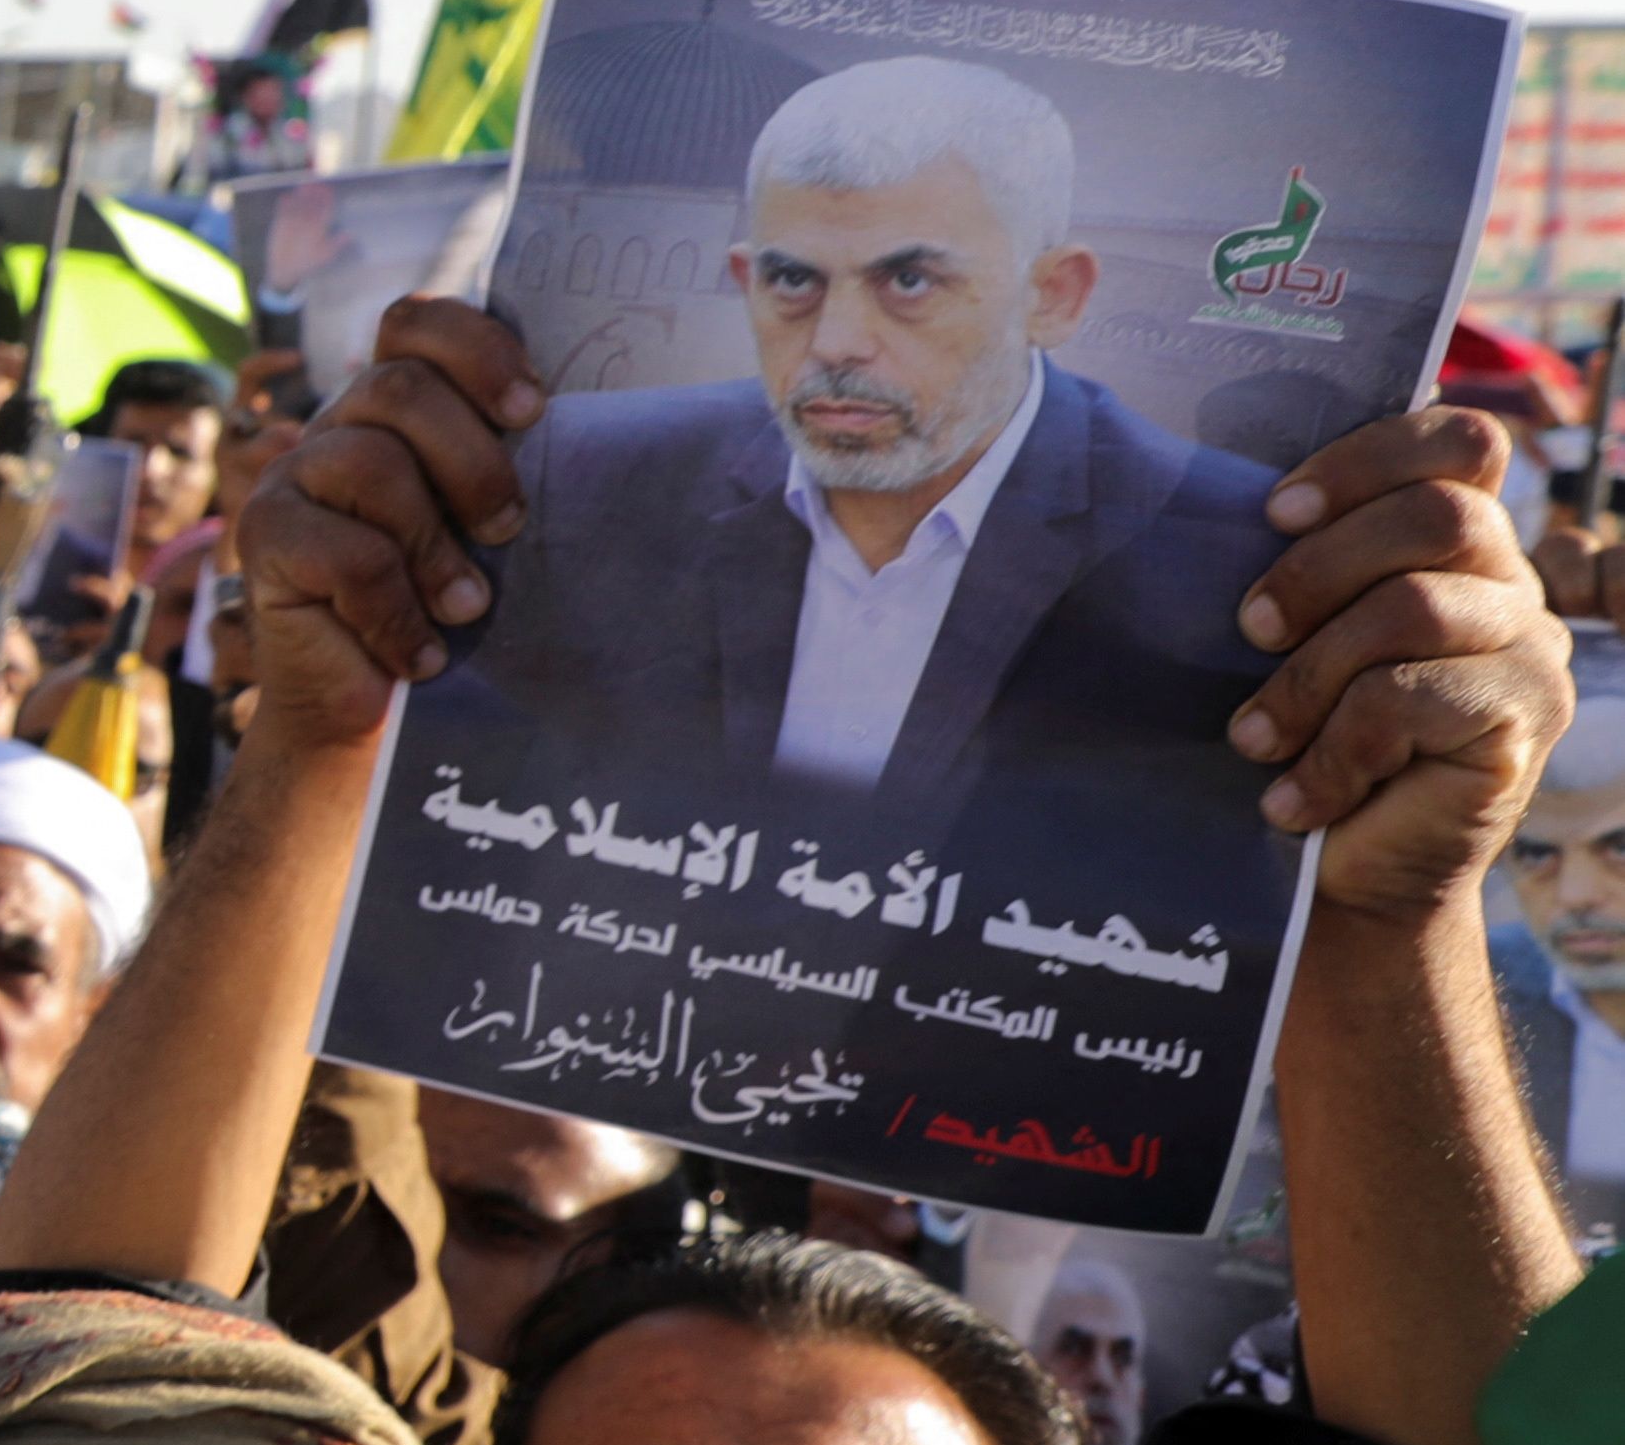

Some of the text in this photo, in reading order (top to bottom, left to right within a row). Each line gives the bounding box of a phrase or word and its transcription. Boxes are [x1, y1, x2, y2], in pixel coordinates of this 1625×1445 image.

[419, 883, 1203, 1078] رئيس المكتب السياسي لحركة حماس
[422, 763, 1229, 993] شهيد الأمة الإسلامية
